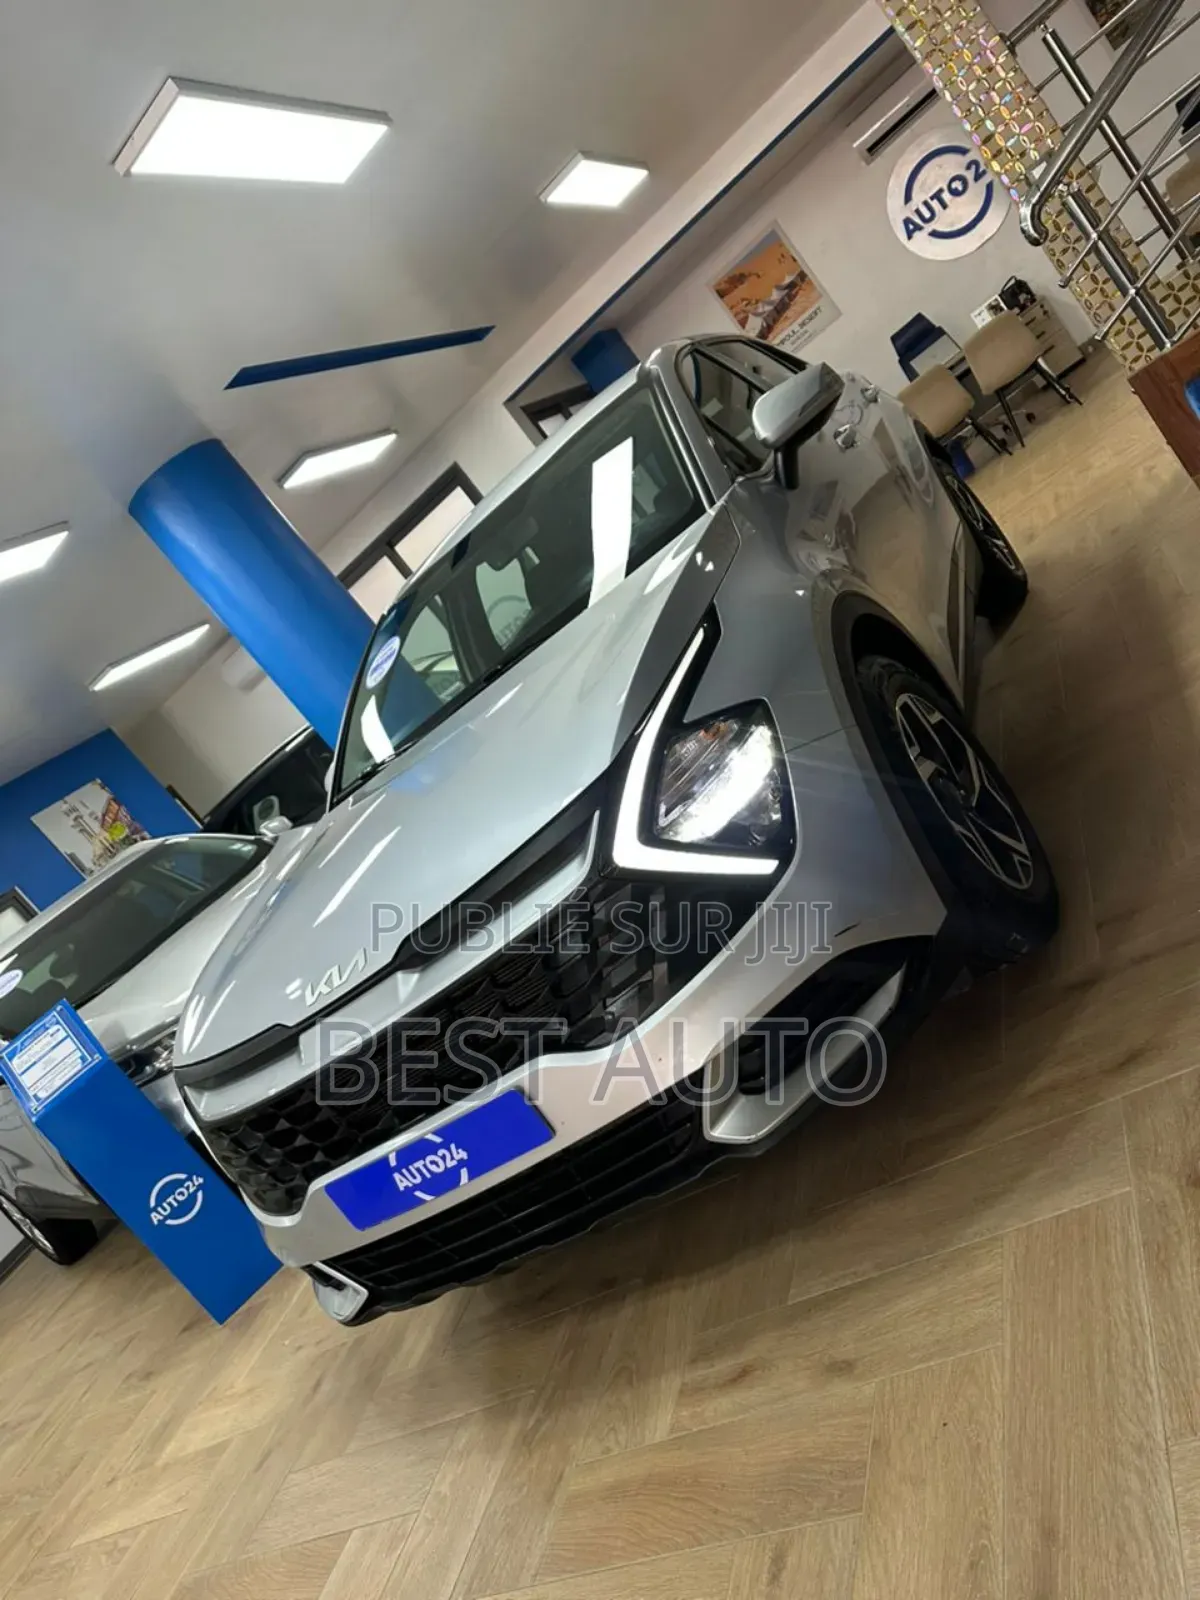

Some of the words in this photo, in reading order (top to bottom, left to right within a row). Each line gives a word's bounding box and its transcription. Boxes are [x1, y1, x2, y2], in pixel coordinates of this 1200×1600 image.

[902, 159, 988, 241] AUTO2
[304, 946, 367, 1008] KIA
[392, 1142, 469, 1191] AUTO24
[150, 1174, 204, 1226] AUTO24
